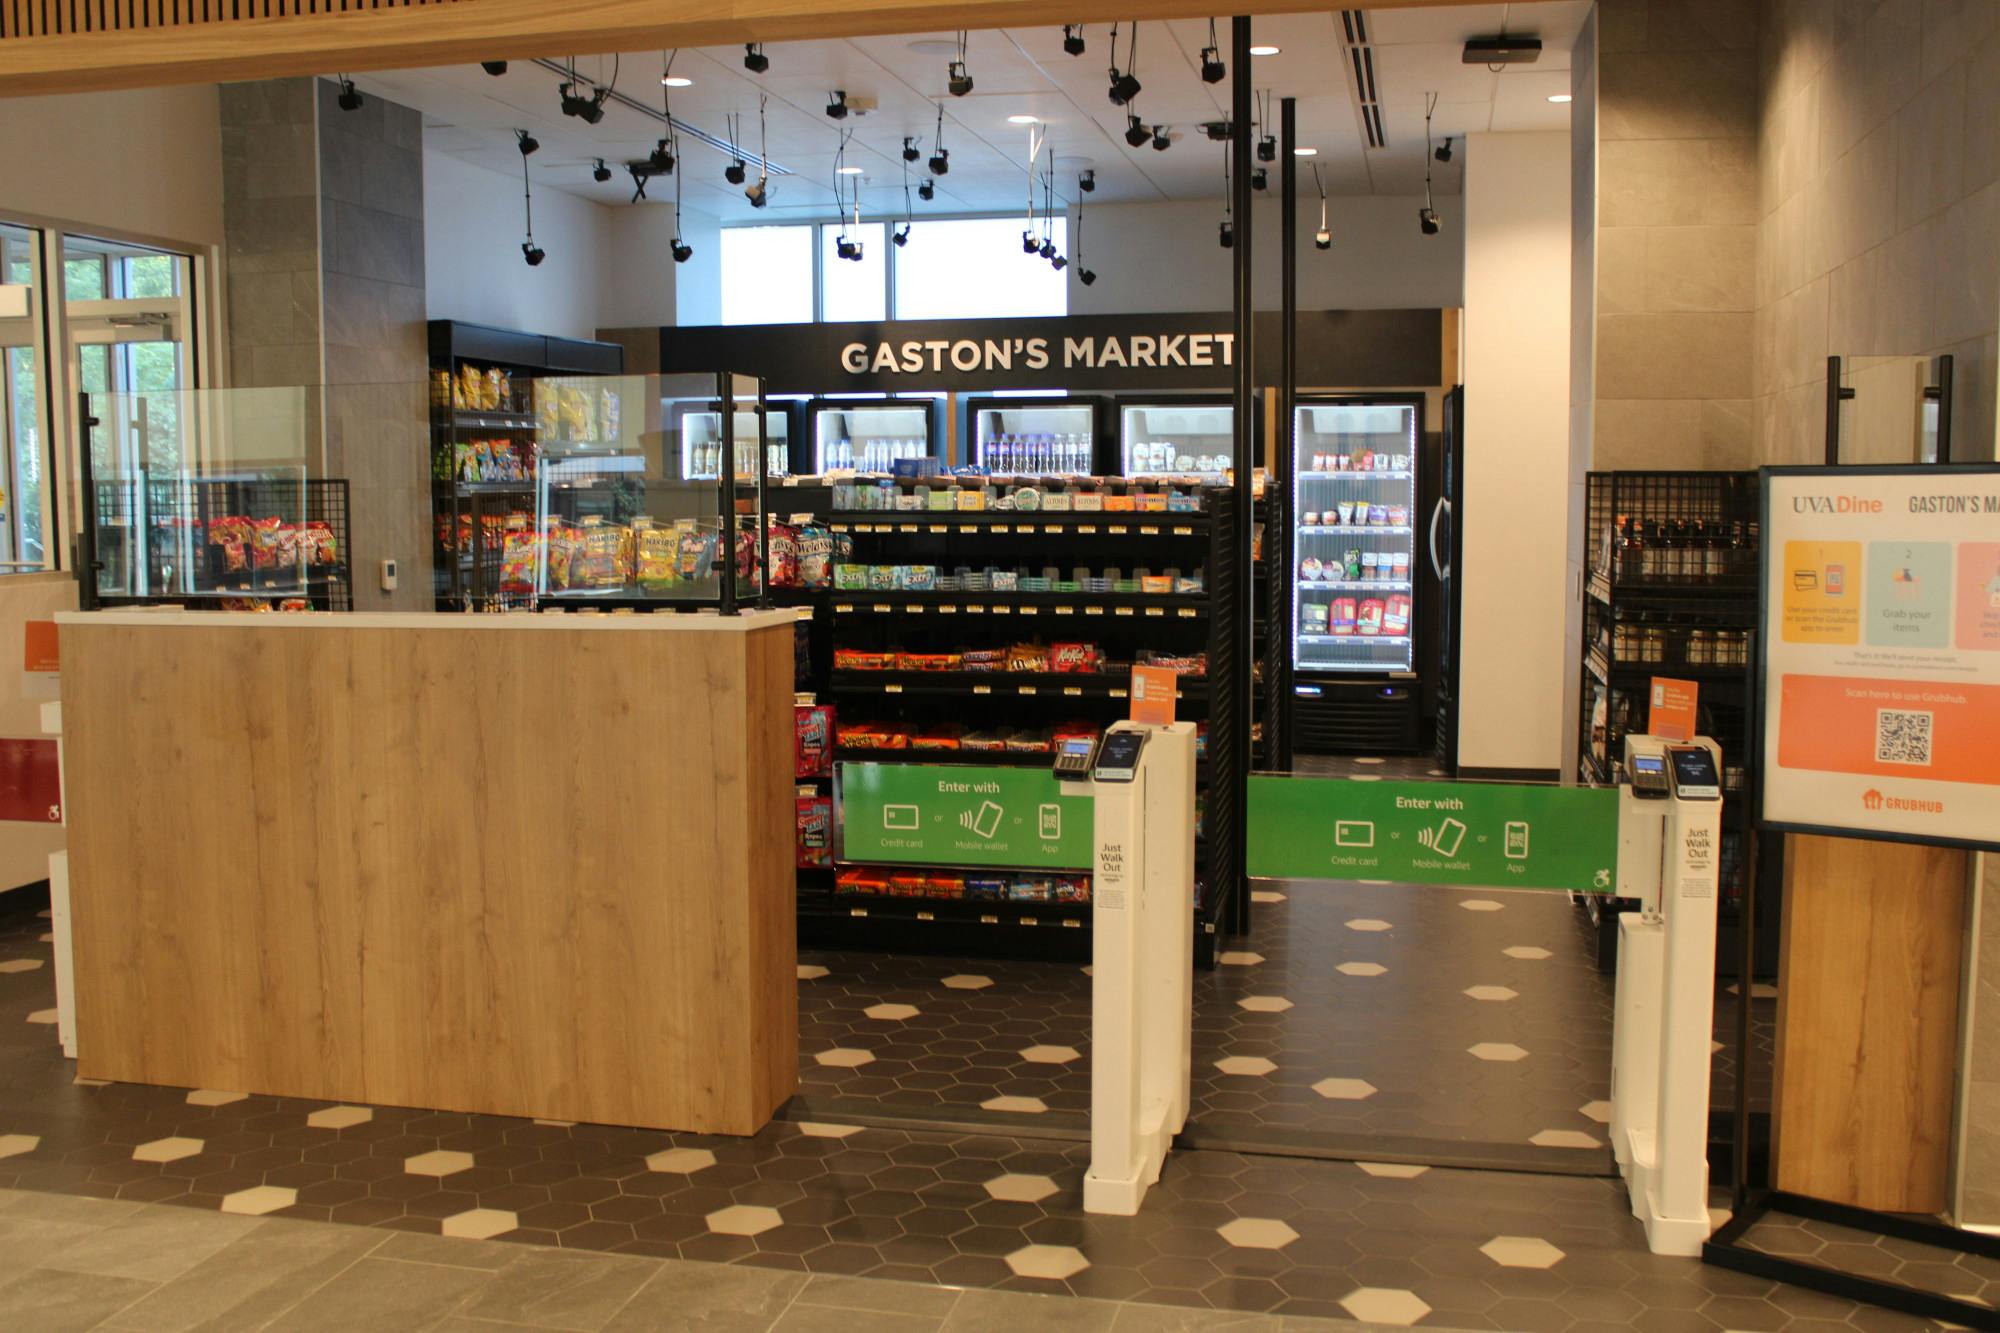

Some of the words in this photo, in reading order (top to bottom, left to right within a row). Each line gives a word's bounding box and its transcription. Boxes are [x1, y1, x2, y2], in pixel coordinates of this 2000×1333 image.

[840, 337, 1050, 374] GASTON'S
[1063, 332, 1235, 369] MARKET
[1908, 495, 1980, 513] GASTON'S
[1882, 609, 1907, 618] Grab
[1908, 611, 1932, 621] your
[1846, 688, 1867, 698] Scan
[1869, 689, 1890, 699] here
[1891, 691, 1903, 700] to
[1904, 693, 1921, 702] use
[938, 780, 970, 793] Enter
[973, 780, 1000, 794] with
[1396, 796, 1431, 809] Enter
[1434, 797, 1464, 810] with
[1886, 797, 1944, 813] GRUBHUB
[1014, 817, 1023, 825] or
[1390, 832, 1400, 840] or
[1688, 828, 1710, 837] Just
[880, 838, 903, 848] Credit
[905, 838, 923, 848] card
[1477, 835, 1487, 843] or
[1685, 838, 1711, 848] Walk
[955, 840, 982, 850] Mobile
[983, 841, 1009, 851] wallet
[1041, 844, 1059, 854] App
[1102, 843, 1121, 852] Just
[1101, 853, 1124, 862] Walk
[1688, 849, 1708, 858] Out
[1331, 855, 1356, 866] Credit
[1358, 857, 1378, 867] card
[1412, 858, 1442, 869] Mobile
[1444, 860, 1471, 871] wallet
[1103, 862, 1121, 872] Out
[1507, 863, 1526, 873] App
